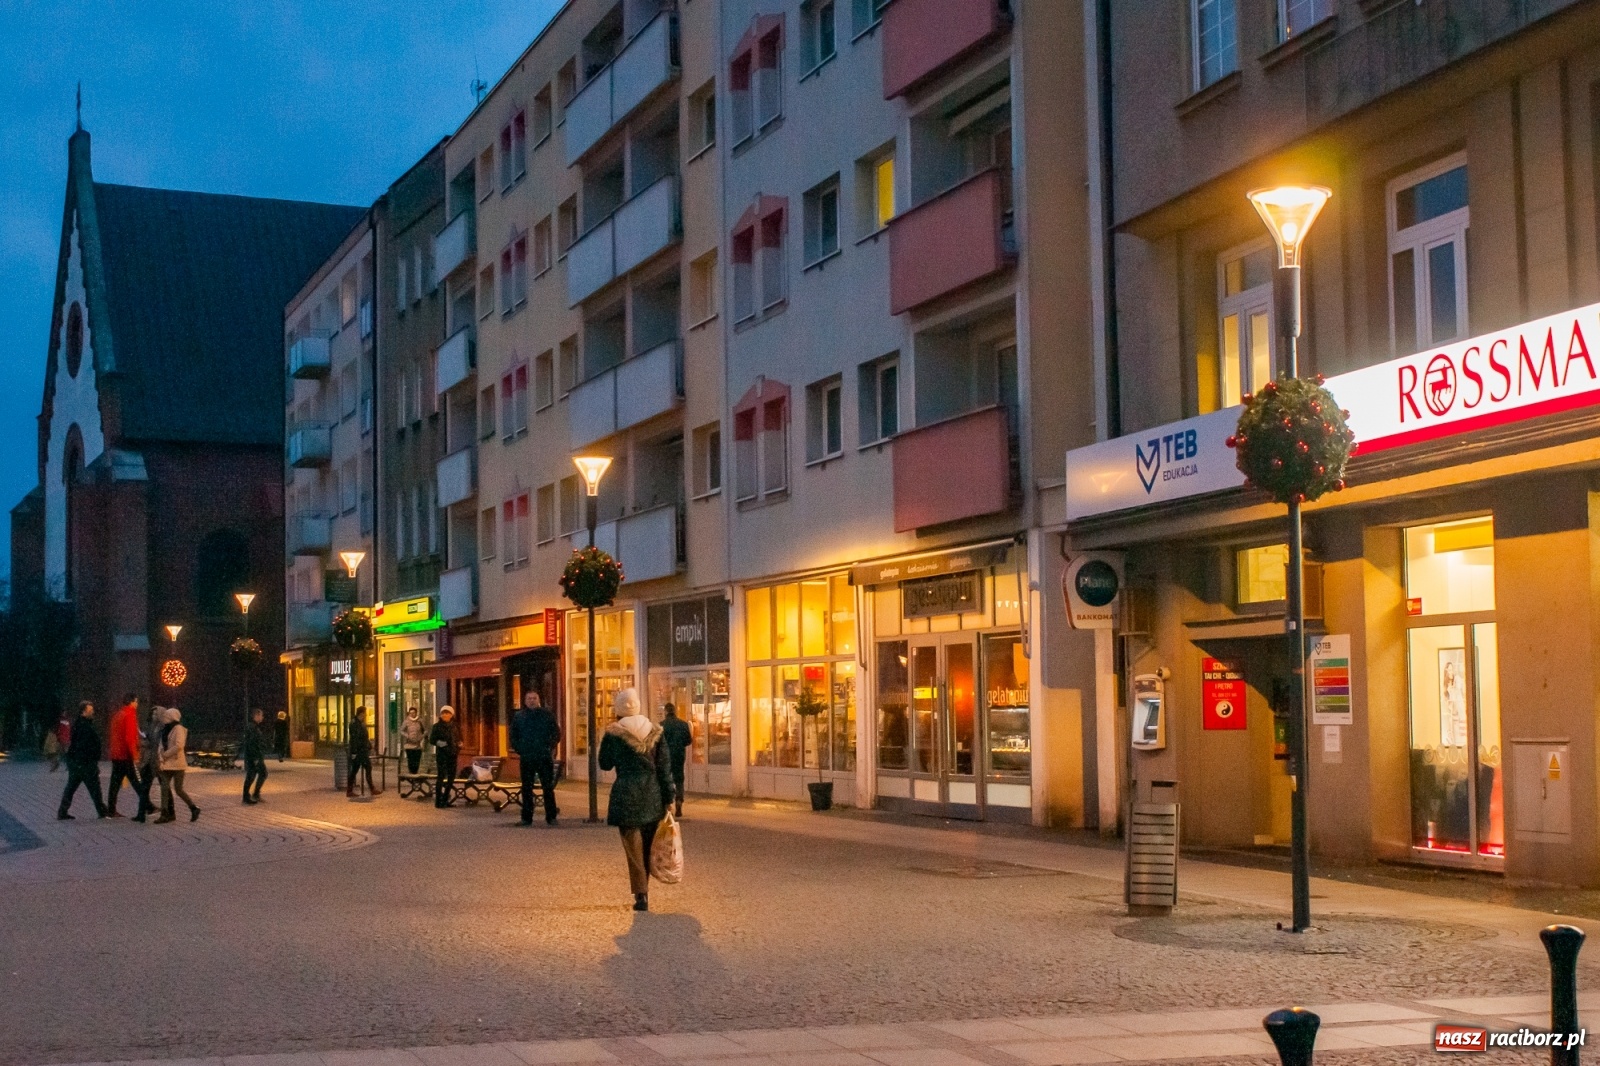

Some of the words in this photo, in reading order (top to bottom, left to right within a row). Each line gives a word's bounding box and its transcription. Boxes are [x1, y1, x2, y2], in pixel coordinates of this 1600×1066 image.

[1162, 429, 1197, 463] TEB
[1163, 464, 1198, 481] EDUKACJA
[1076, 613, 1118, 621] BANKOMAT
[675, 614, 702, 646] empik
